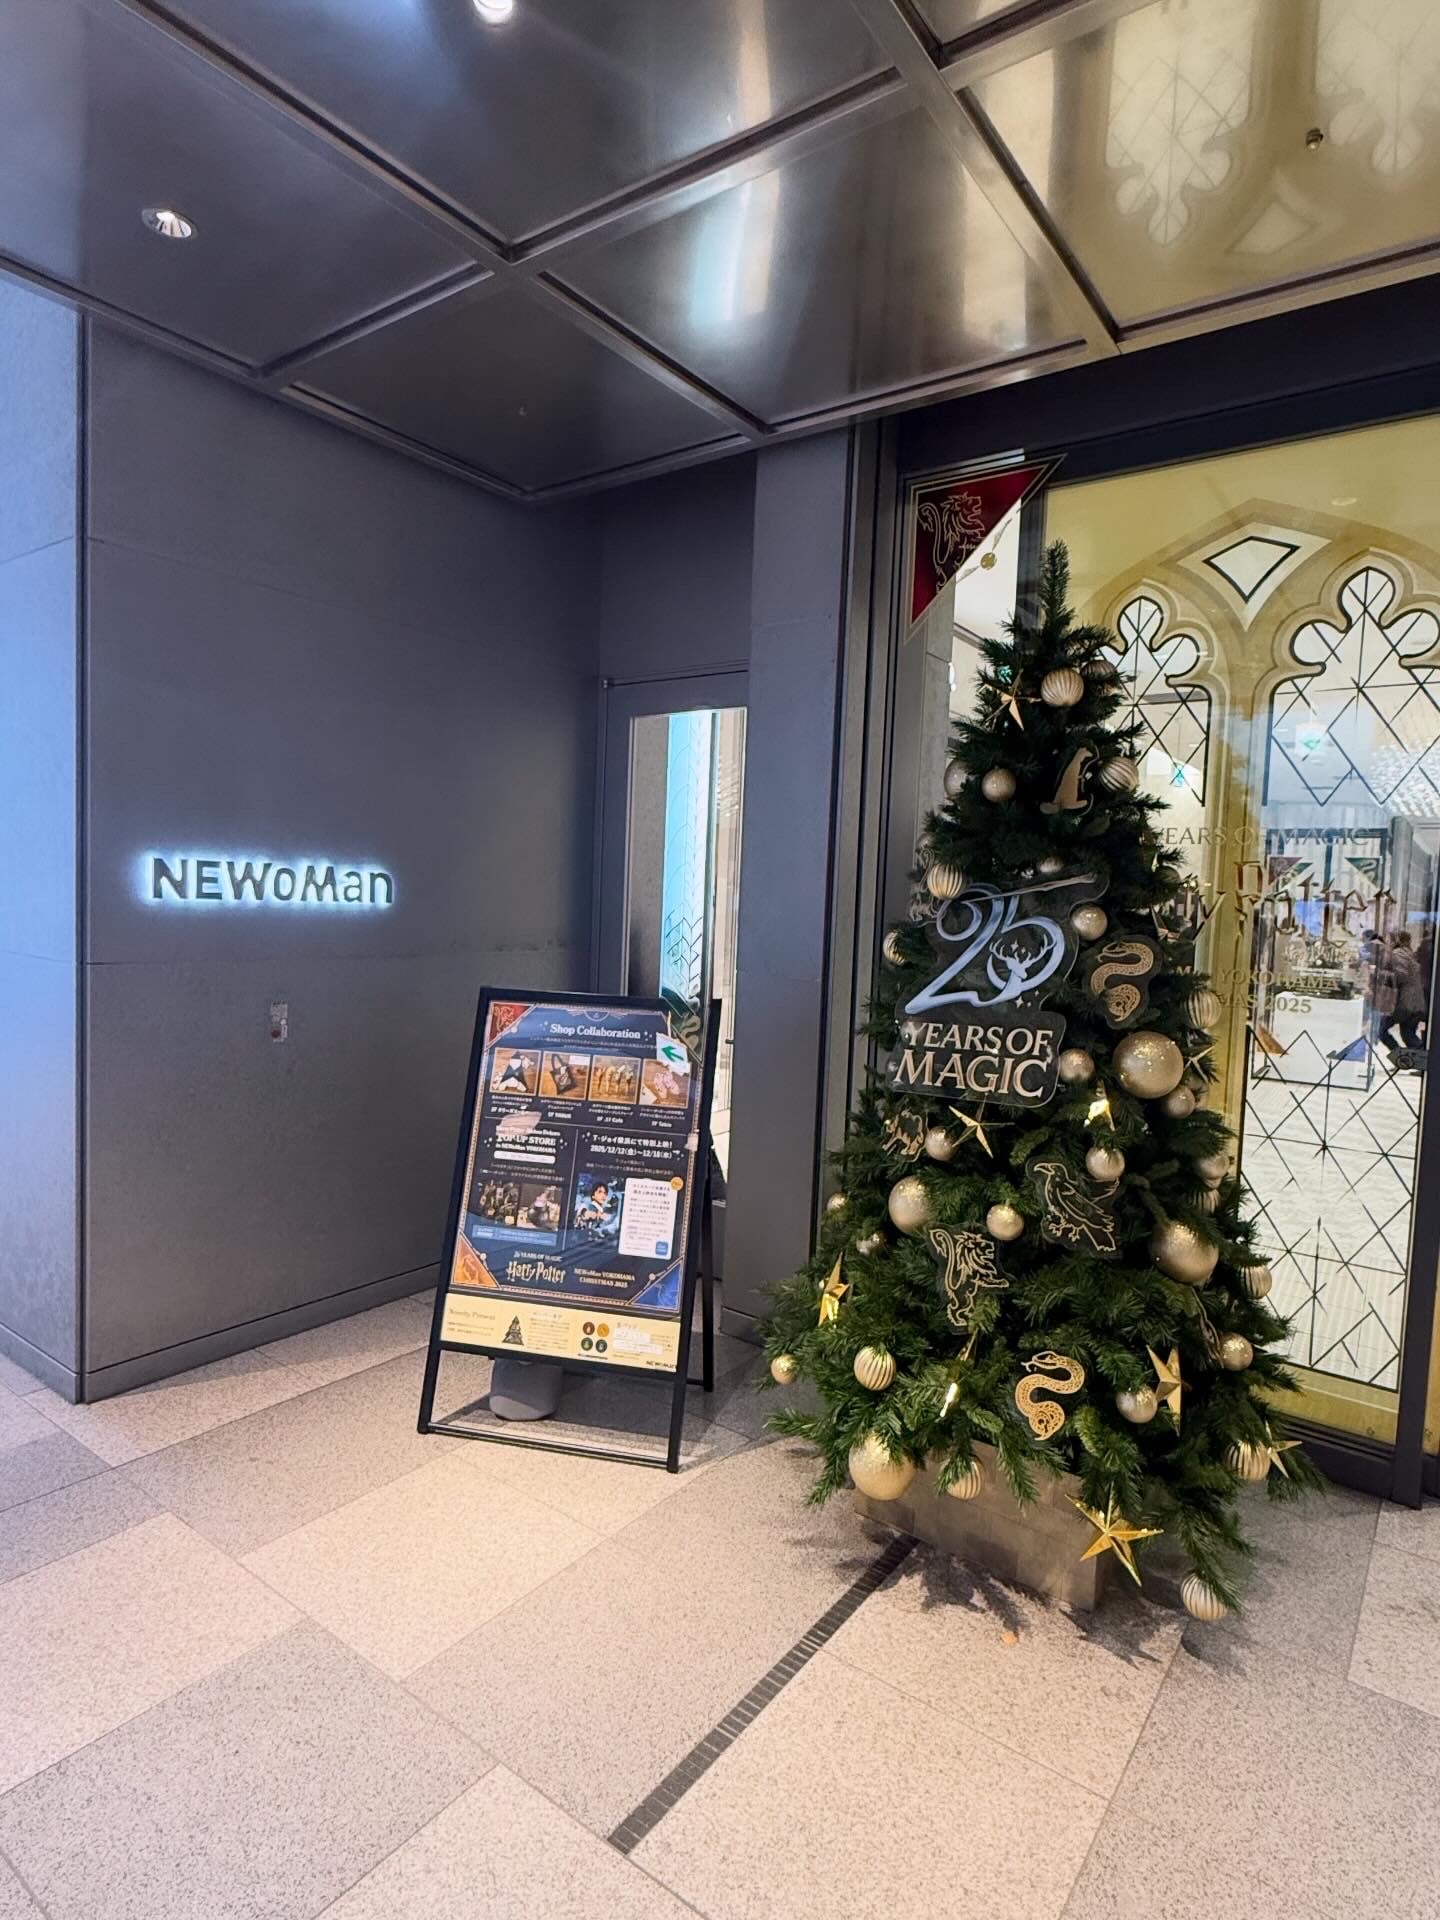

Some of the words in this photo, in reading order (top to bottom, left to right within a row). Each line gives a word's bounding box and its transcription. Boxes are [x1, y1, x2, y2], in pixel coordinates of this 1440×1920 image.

[152, 857, 393, 904] NEWoMan
[904, 882, 1065, 1014] 25
[550, 1023, 575, 1036] Shop
[577, 1026, 641, 1039] Collaboration
[907, 1022, 1004, 1053] YEARS
[1006, 1027, 1054, 1056] OF
[894, 1049, 1048, 1098] MAGIC
[528, 1136, 556, 1146] STORE
[506, 1260, 535, 1282] Harry
[536, 1261, 566, 1283] Potter
